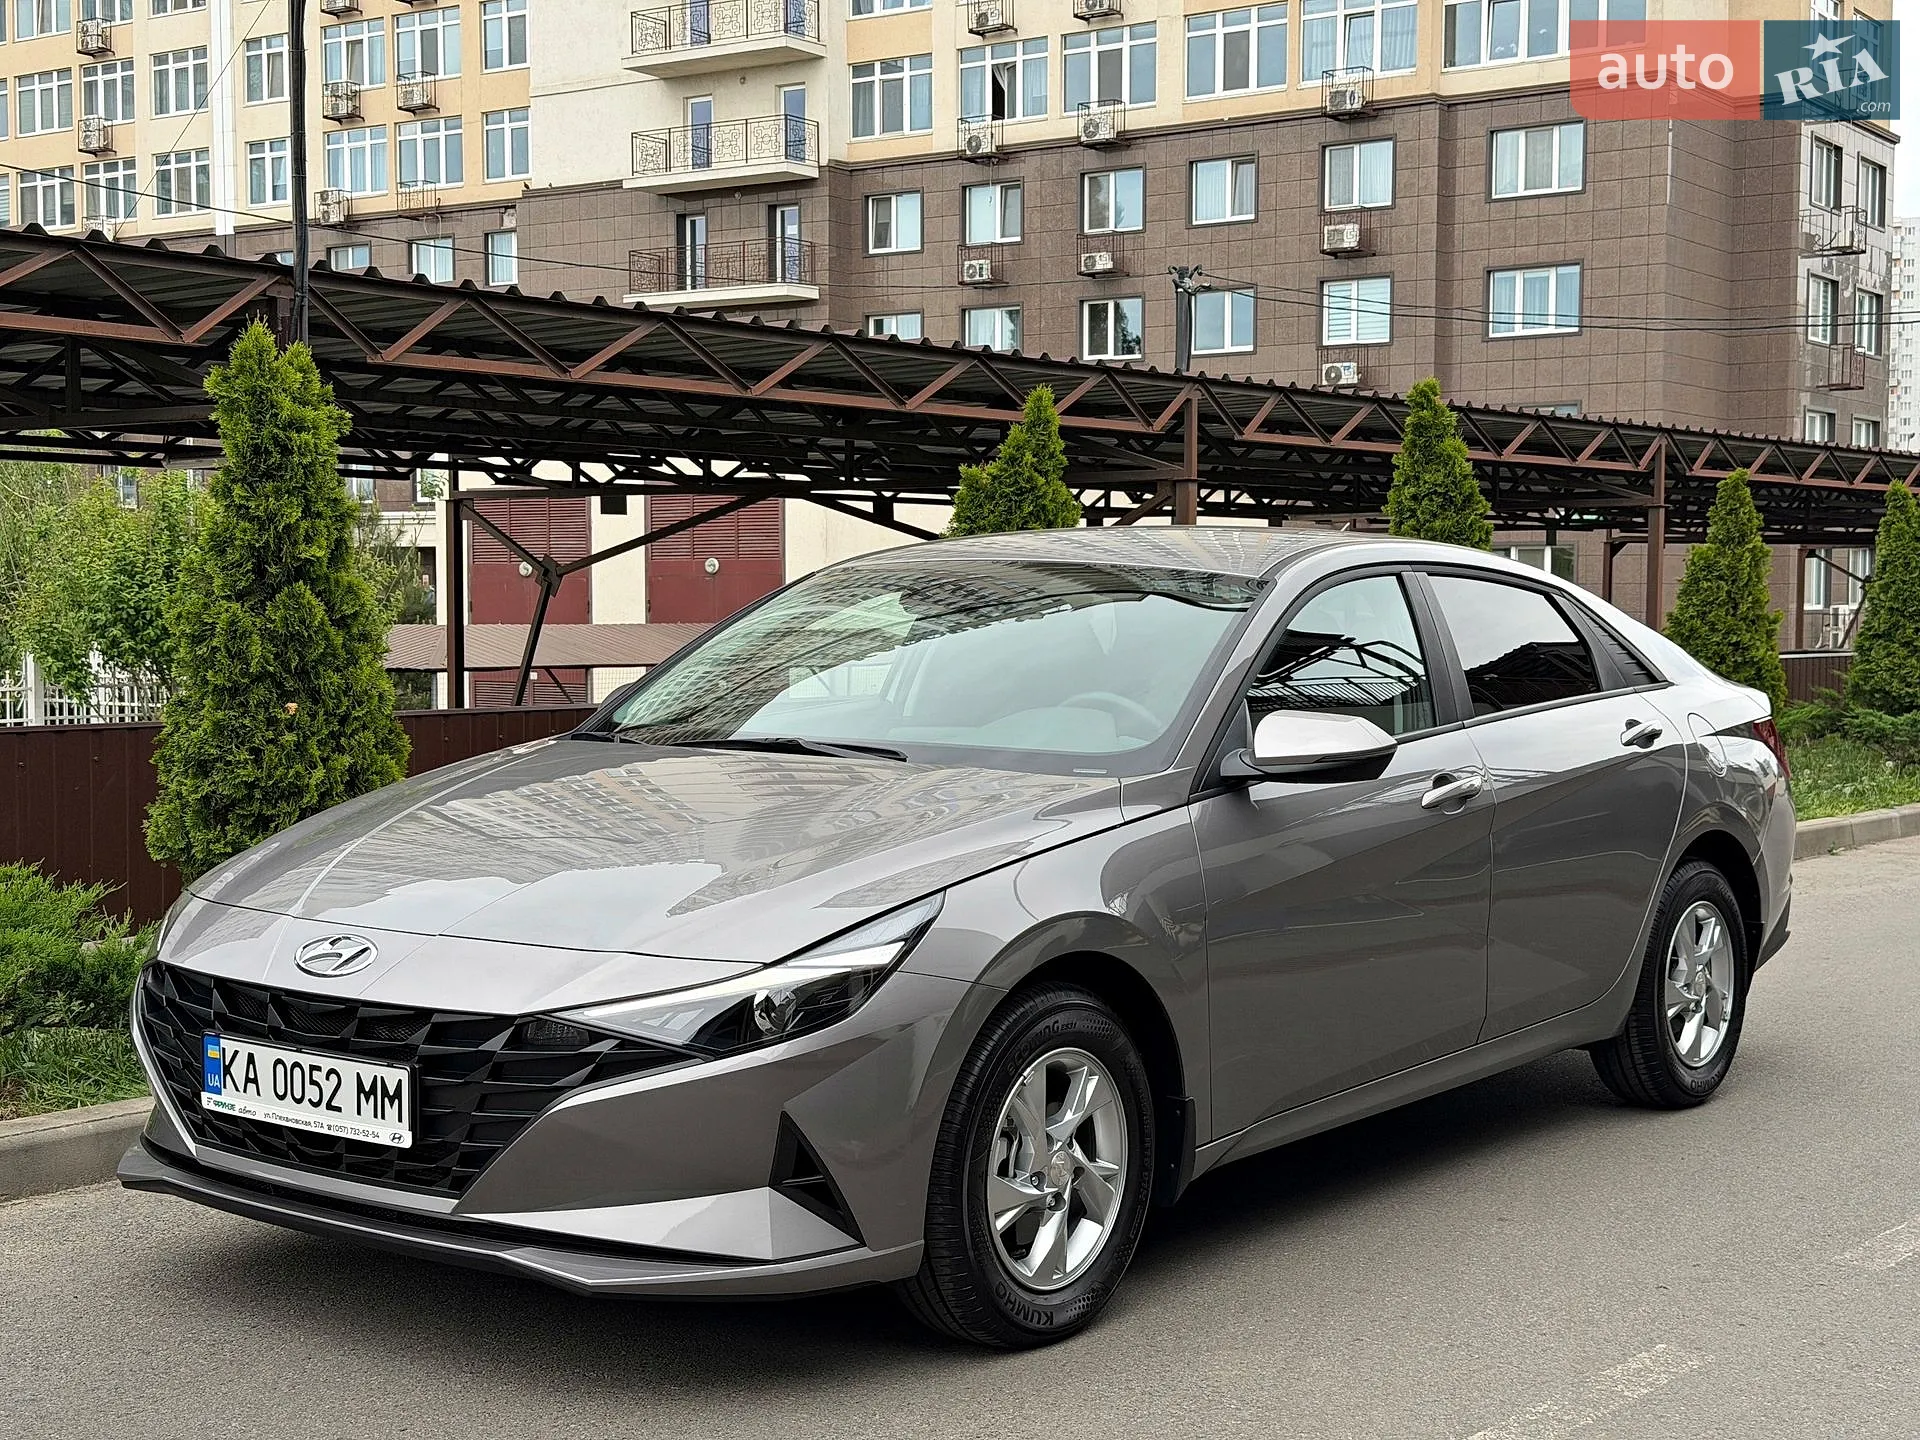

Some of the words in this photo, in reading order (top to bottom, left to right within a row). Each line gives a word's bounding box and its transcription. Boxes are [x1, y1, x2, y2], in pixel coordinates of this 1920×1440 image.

[208, 1073, 221, 1088] UA
[222, 1047, 262, 1097] KA
[272, 1057, 343, 1113] 0052
[356, 1071, 403, 1124] MM
[350, 1127, 380, 1139] 732-52-54
[995, 1281, 1054, 1326] KUMHO
